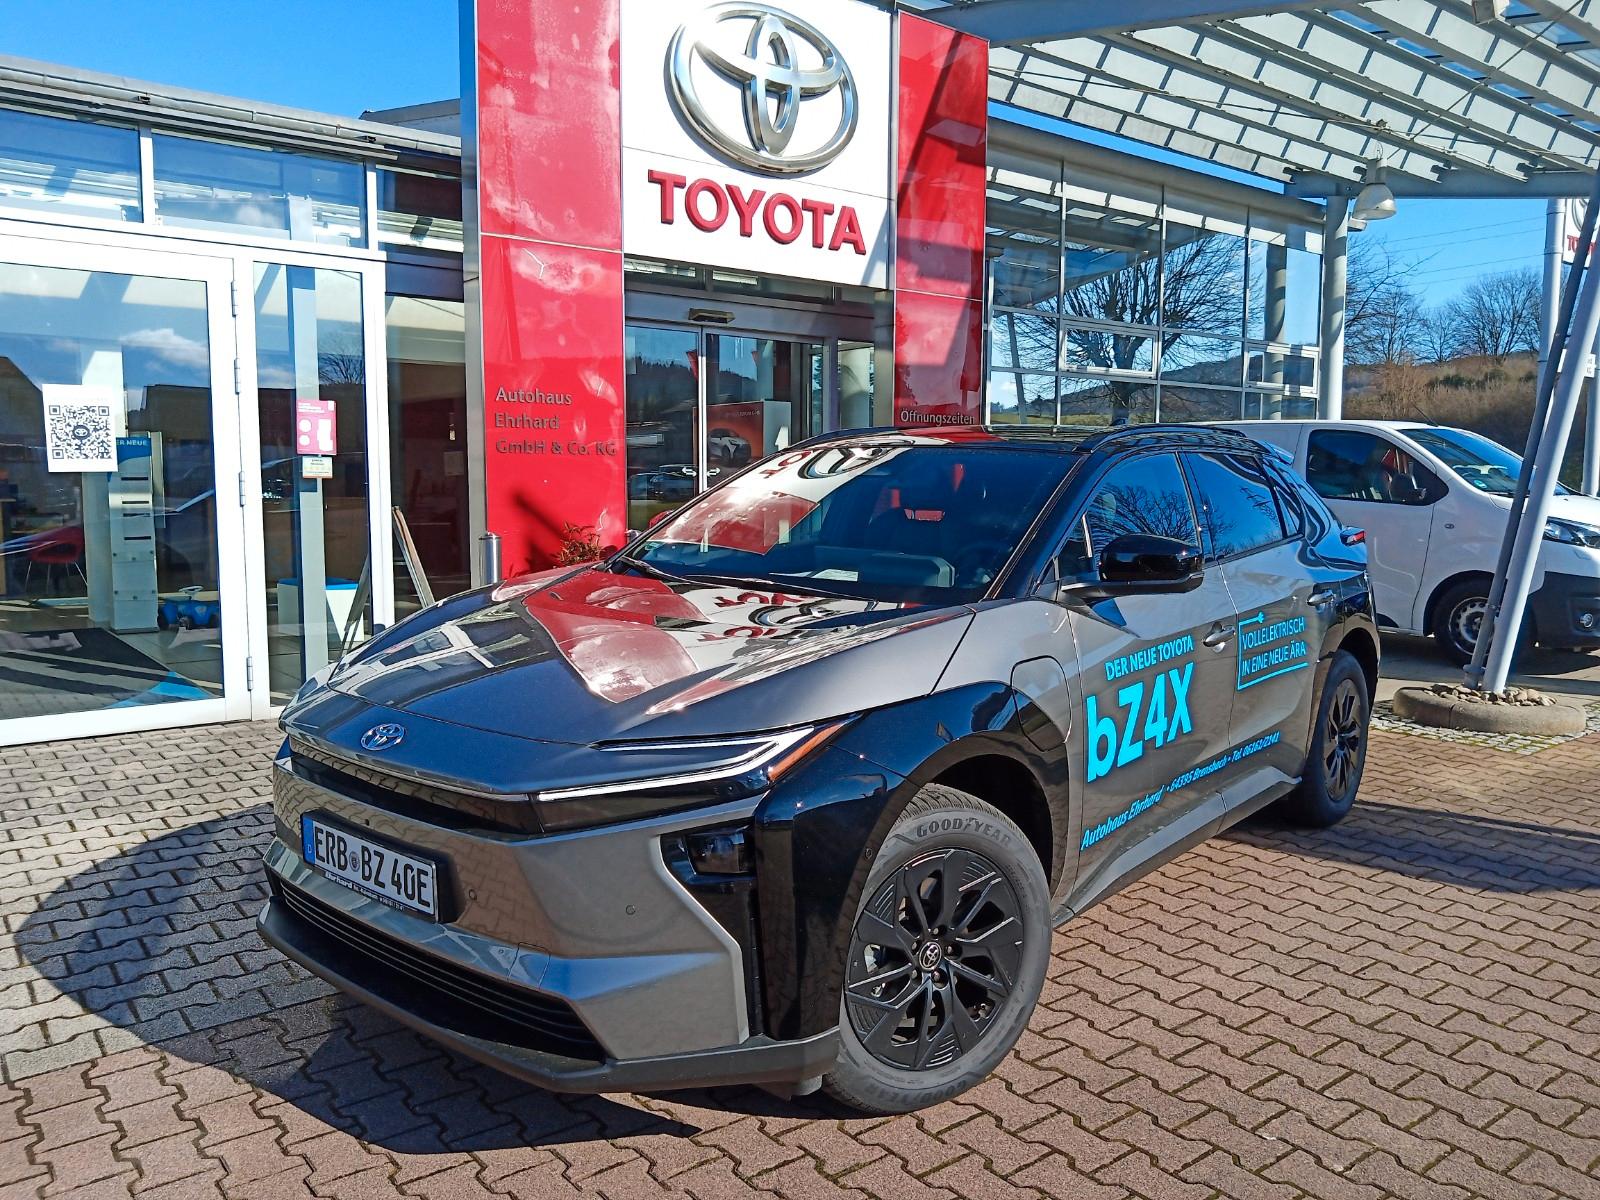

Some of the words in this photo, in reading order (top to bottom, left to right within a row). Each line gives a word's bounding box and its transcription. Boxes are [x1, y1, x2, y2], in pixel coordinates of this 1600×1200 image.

[648, 169, 866, 255] TOYOTA
[495, 386, 573, 405] Autohaus
[495, 412, 561, 429] Ehrhard
[901, 408, 975, 427] Öffnungszeiten
[495, 439, 546, 455] GmbH
[551, 441, 562, 455] &
[568, 442, 590, 456] Co.
[596, 442, 617, 456] KG
[1242, 616, 1305, 650] VOLLELEKTRISCH
[1105, 657, 1129, 681] DER
[1129, 647, 1157, 673] NEUE
[1158, 634, 1194, 662] TOYOTA
[1242, 659, 1250, 677] IN
[1251, 652, 1269, 673] EINE
[1269, 645, 1289, 666] NEUE
[1289, 640, 1306, 659] ÄRA
[1086, 662, 1194, 783] bZ4X
[1080, 810, 1129, 851] Autohaus
[1128, 784, 1165, 820] Ehrhard
[1192, 754, 1228, 781] Brensbach
[916, 817, 1011, 847] GOODYEAR
[314, 825, 348, 872] ERB
[360, 844, 386, 890] BZ
[390, 857, 431, 908] 40E
